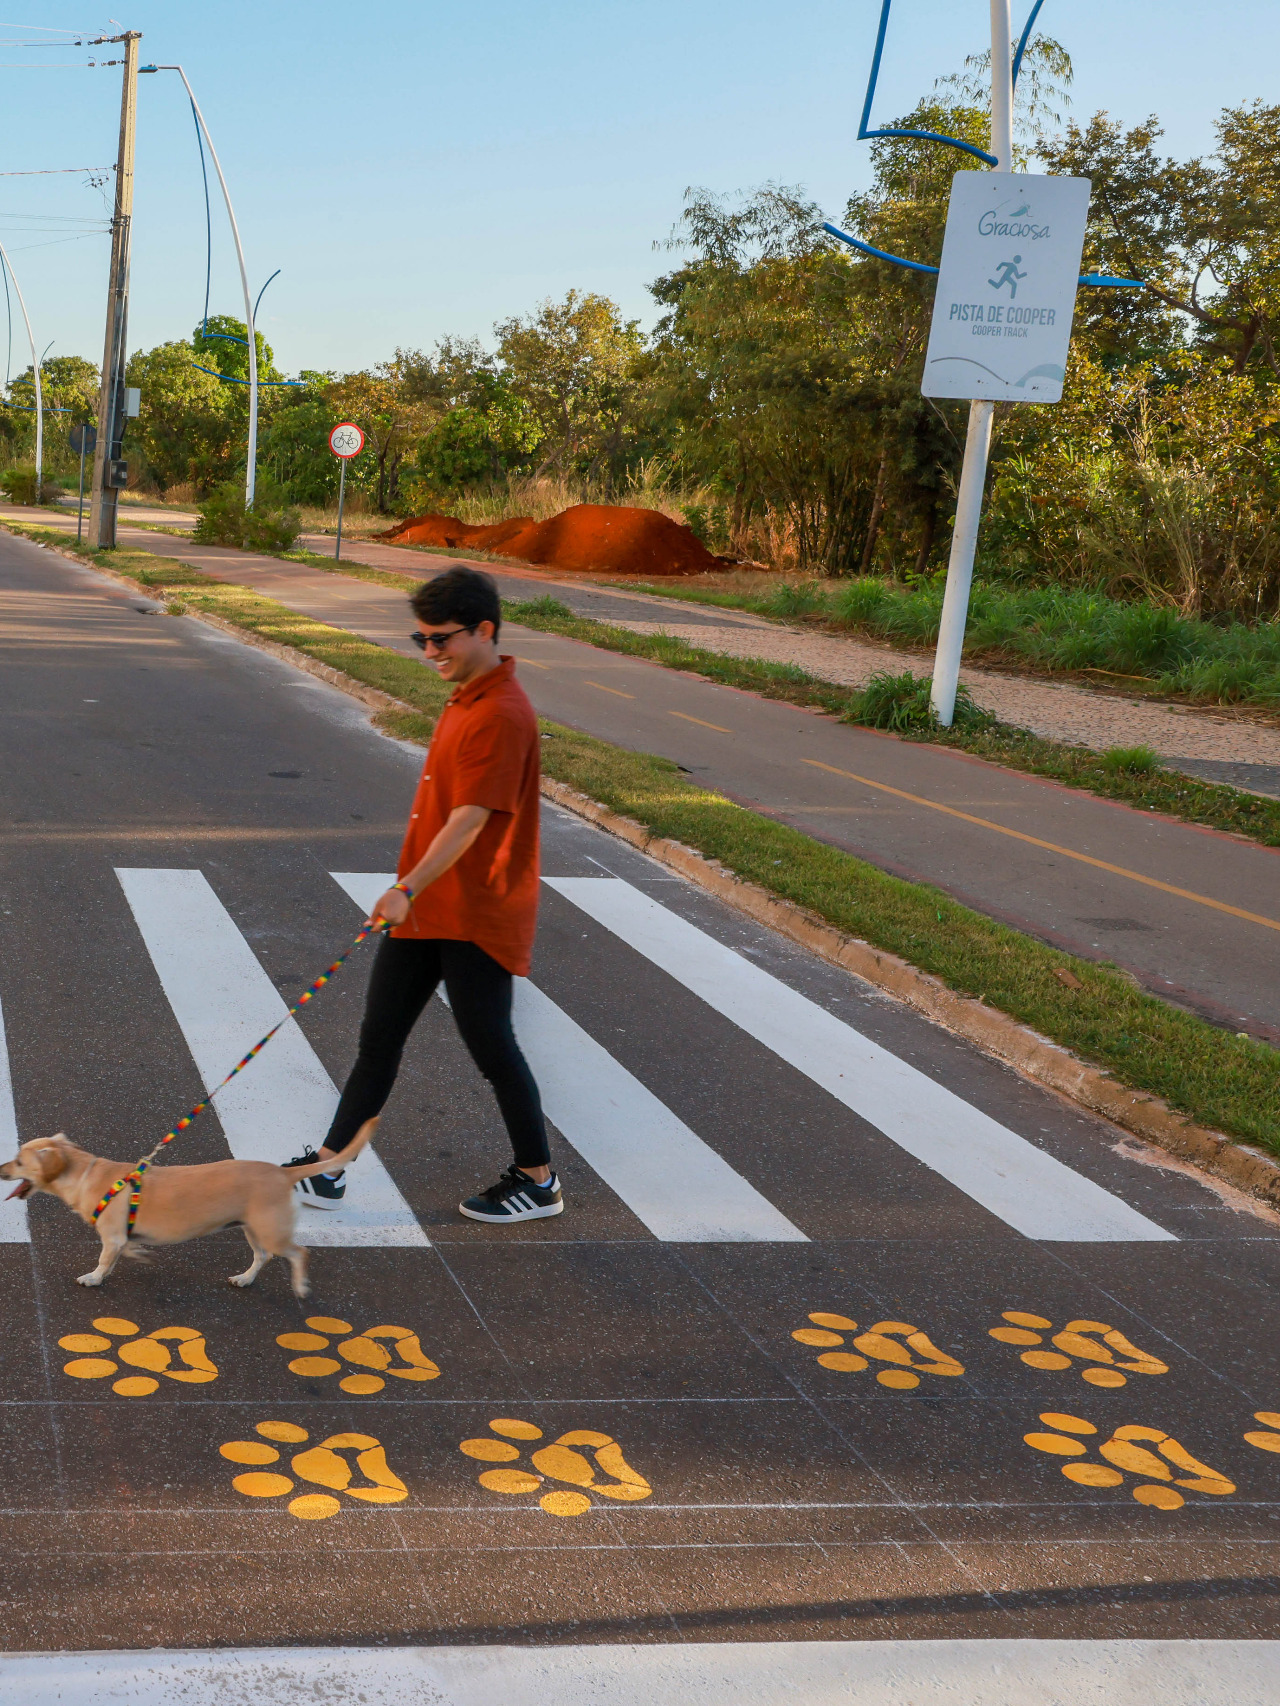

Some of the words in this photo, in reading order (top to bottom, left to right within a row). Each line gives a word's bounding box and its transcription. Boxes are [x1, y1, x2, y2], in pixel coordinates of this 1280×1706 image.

[978, 210, 1051, 240] Graciosa
[949, 303, 984, 322] PISTA
[987, 305, 1005, 323] DE
[1006, 306, 1056, 326] COOPER
[972, 324, 1002, 337] COOPER
[1003, 326, 1028, 338] TRACK
